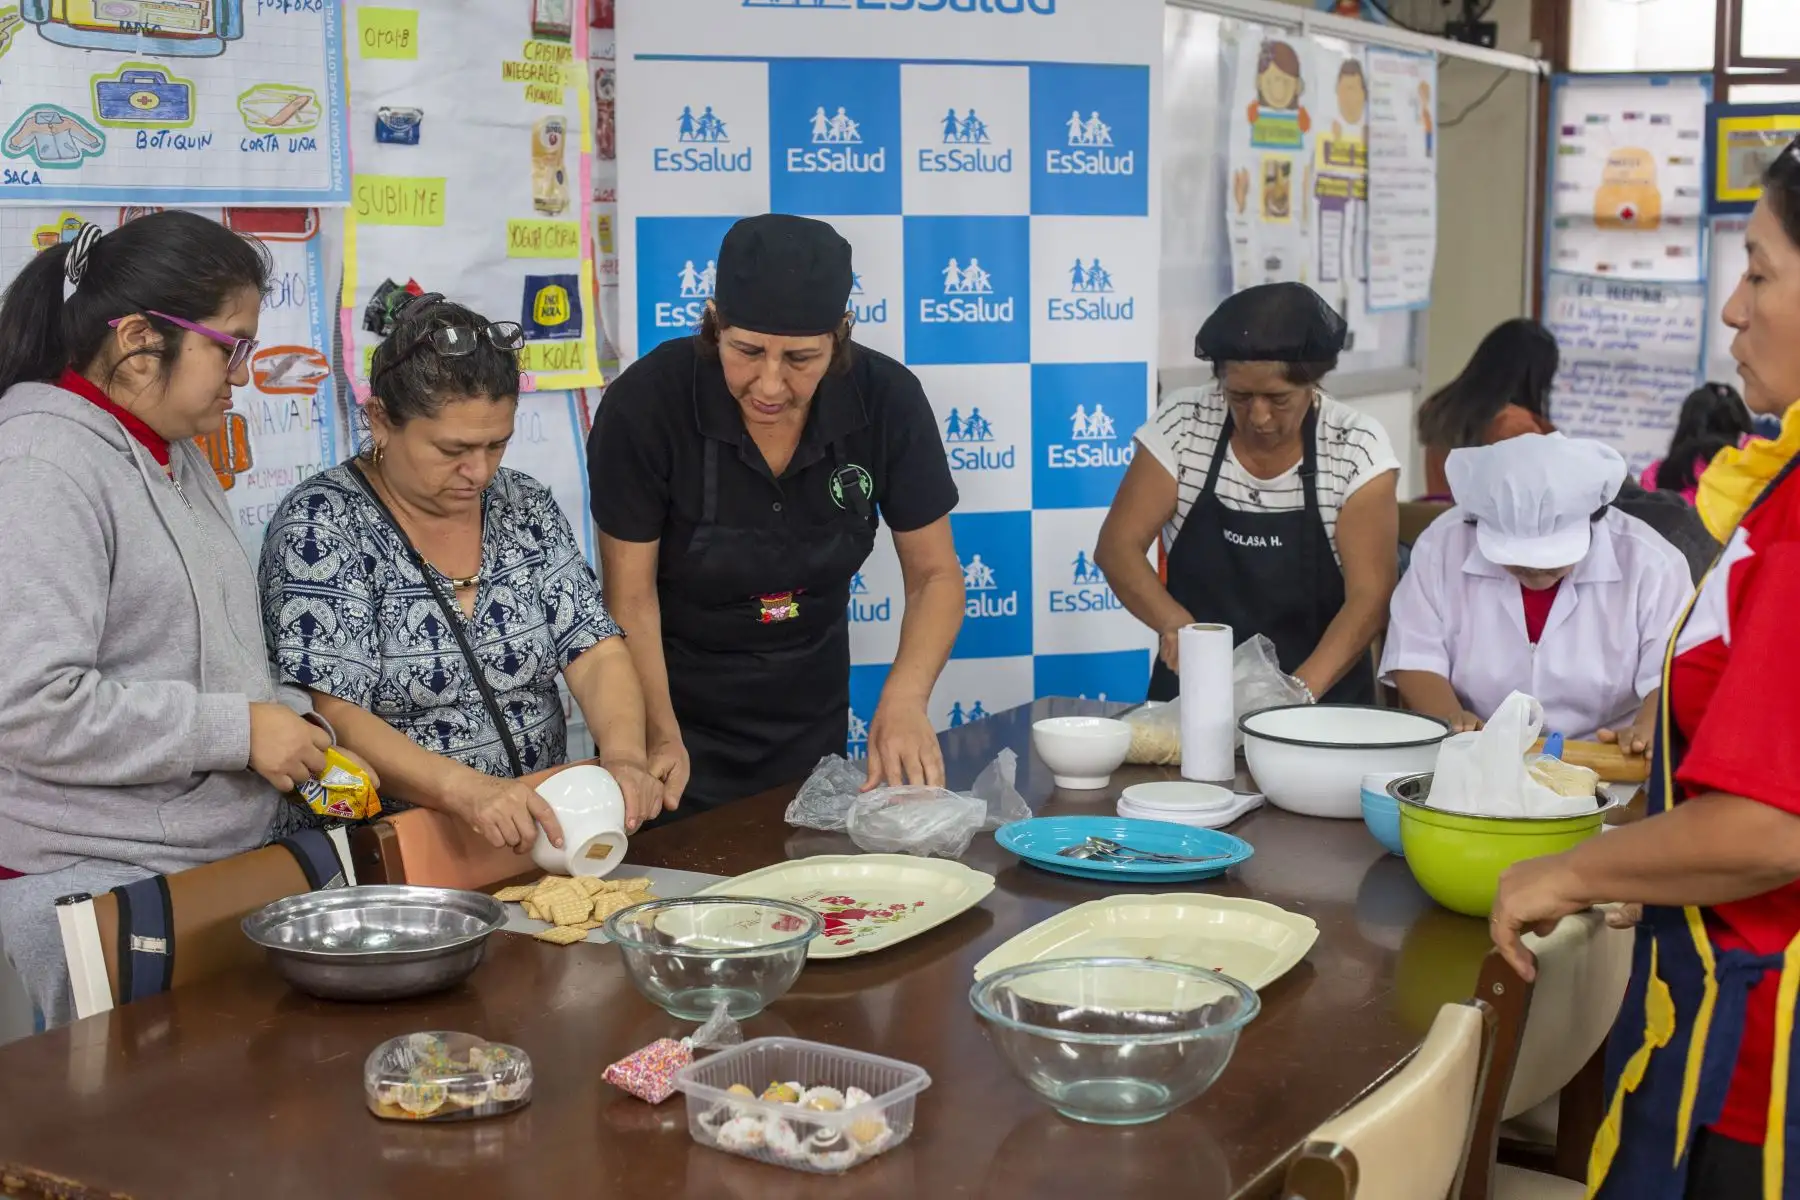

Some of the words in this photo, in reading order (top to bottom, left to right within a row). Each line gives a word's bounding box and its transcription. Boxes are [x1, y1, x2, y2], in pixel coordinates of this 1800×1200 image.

[654, 147, 752, 172] EsSalud
[787, 147, 886, 173] EsSalud
[919, 148, 1013, 173] EsSalud
[1046, 149, 1135, 175] EsSalud
[919, 297, 1014, 323] EsSalud
[1047, 297, 1134, 321] EsSalud
[947, 445, 1015, 470] Salud
[1047, 442, 1135, 469] EsSalud
[1270, 535, 1282, 547] H.
[964, 590, 1018, 617] alud
[1049, 589, 1124, 613] EsSalu
